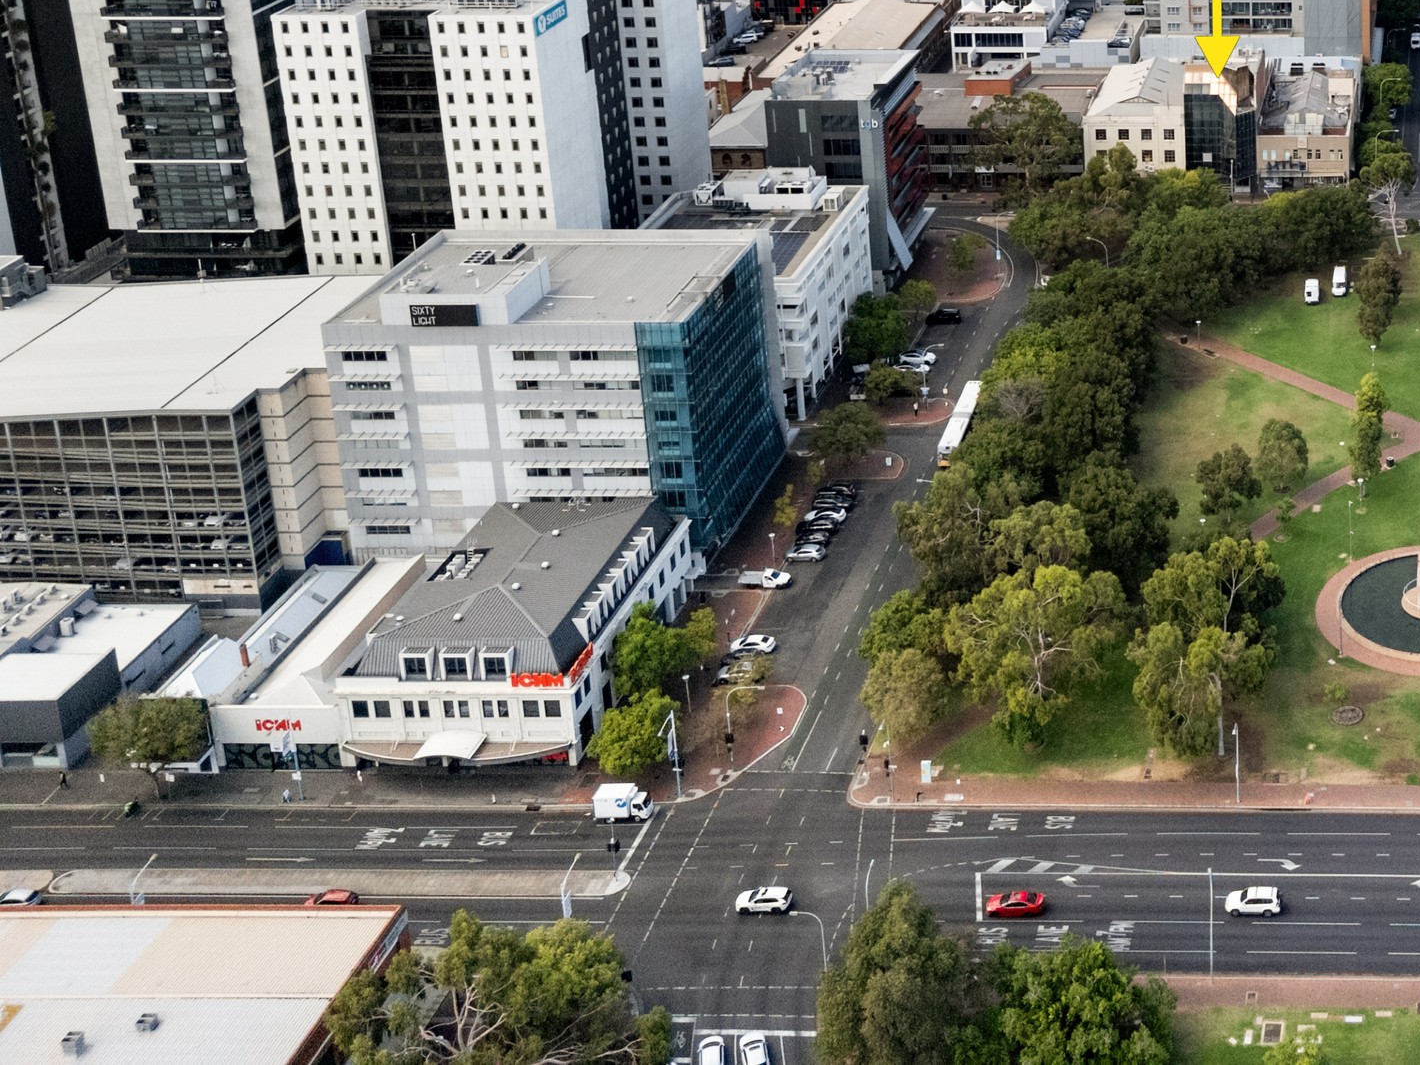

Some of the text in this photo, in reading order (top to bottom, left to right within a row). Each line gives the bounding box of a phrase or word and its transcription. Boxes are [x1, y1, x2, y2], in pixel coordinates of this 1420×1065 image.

[546, 4, 566, 25] SUITES
[860, 118, 878, 130] tgb
[411, 306, 435, 315] SIXTY
[412, 316, 436, 325] LIGHT
[1044, 815, 1076, 829] BUS
[477, 831, 514, 846] BUS
